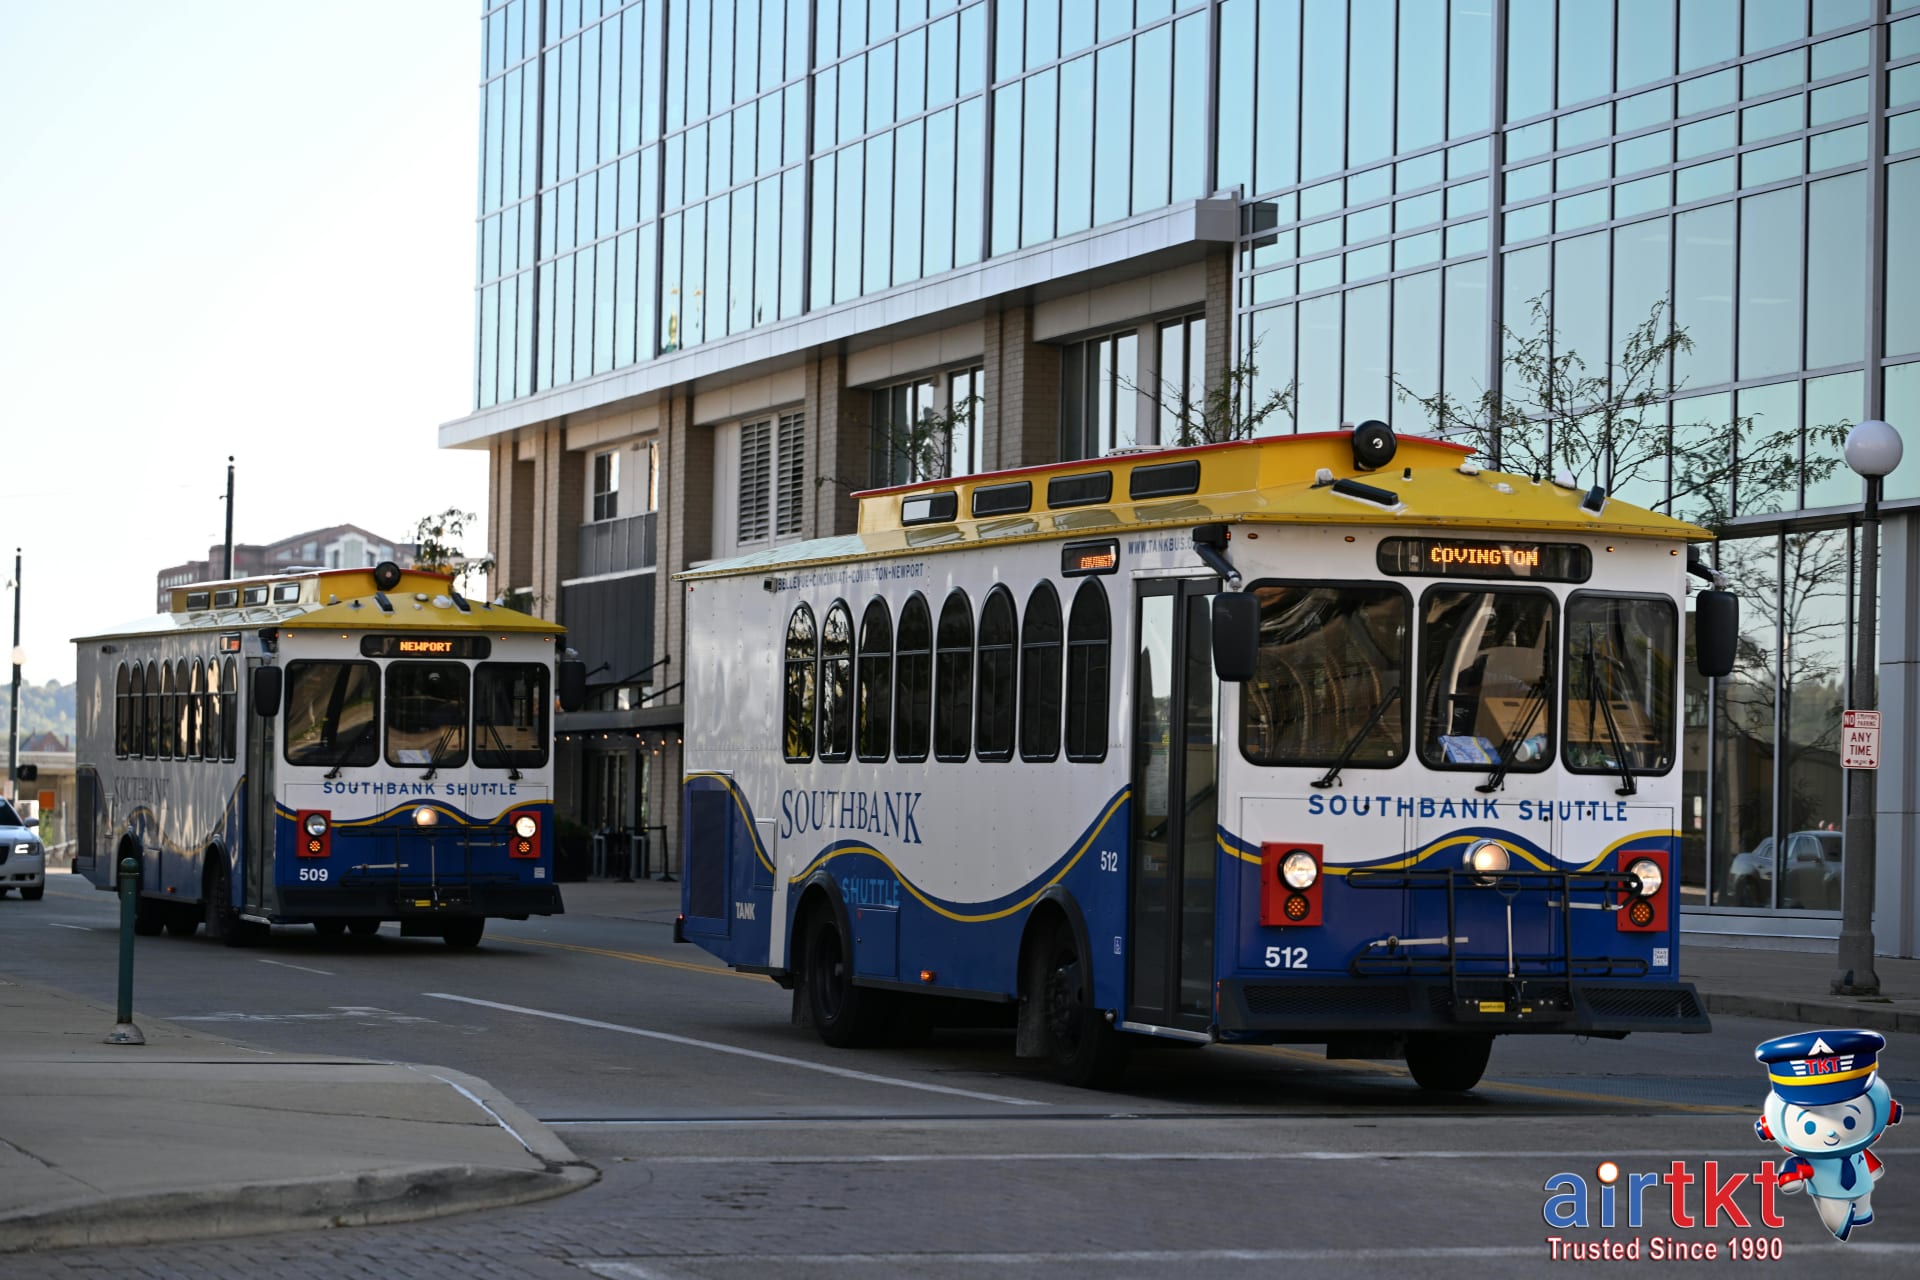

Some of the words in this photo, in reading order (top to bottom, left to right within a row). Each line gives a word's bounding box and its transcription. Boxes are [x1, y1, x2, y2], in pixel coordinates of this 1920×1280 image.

[1128, 537, 1195, 555] WWW.TANKBUS.O
[1431, 547, 1538, 566] COVINGTON
[400, 641, 452, 651] NEWPORT
[1845, 714, 1855, 726] NO
[1850, 732, 1872, 743] ANY
[1849, 745, 1872, 756] TIME
[323, 782, 435, 795] SOUTHBANK
[446, 784, 517, 795] SHUTTLE
[781, 789, 922, 844] SOUTHBANK
[1308, 794, 1500, 819] SOUTHBANK
[1518, 800, 1627, 821] SHUTTLE
[1100, 851, 1118, 872] 512
[299, 868, 328, 882] 509
[841, 877, 900, 906] SHUTTLE
[735, 902, 755, 920] TANK
[1265, 946, 1308, 968] 512
